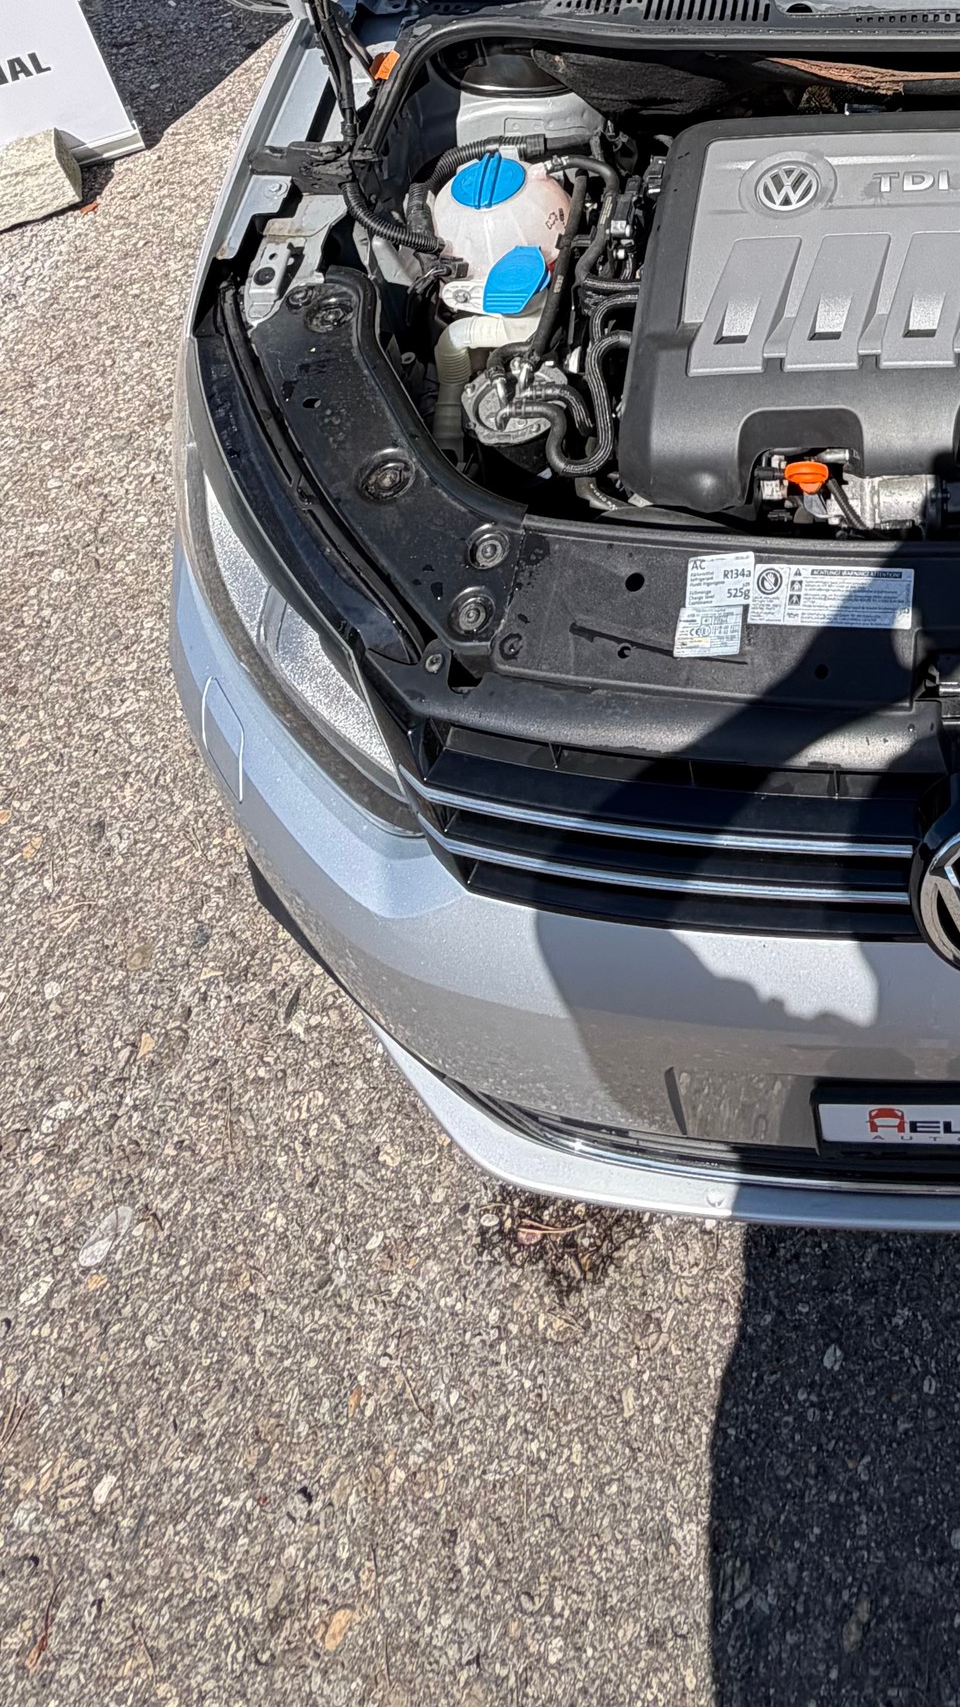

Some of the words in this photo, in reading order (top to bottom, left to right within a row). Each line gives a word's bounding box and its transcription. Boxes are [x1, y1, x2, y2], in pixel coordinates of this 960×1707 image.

[873, 170, 950, 192] TDI
[691, 559, 706, 570] AC
[723, 568, 752, 580] R134a
[727, 587, 751, 600] 525g
